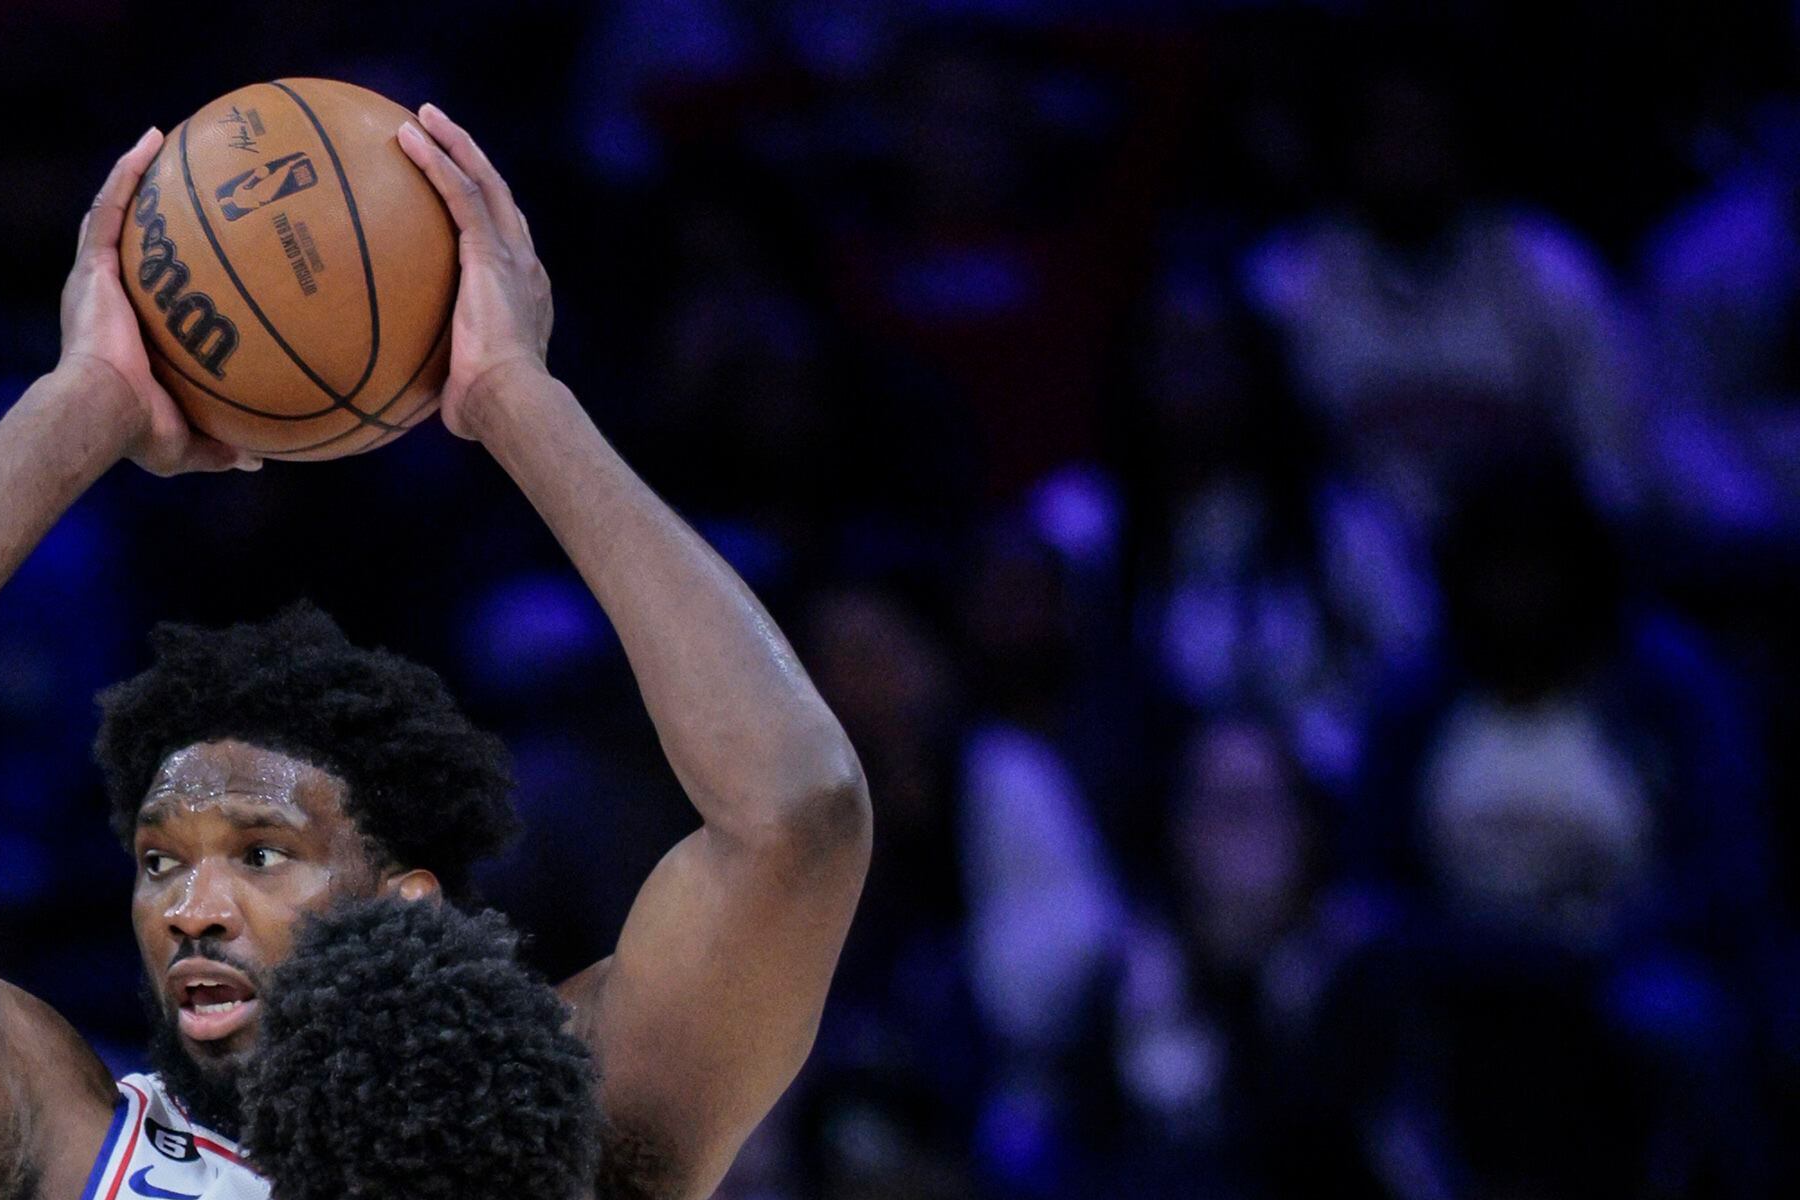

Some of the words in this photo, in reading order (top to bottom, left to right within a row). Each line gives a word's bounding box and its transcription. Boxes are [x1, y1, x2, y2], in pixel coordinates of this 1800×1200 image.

[271, 212, 292, 236] BALL
[280, 232, 302, 259] GAME
[135, 160, 239, 381] Wilso
[290, 256, 318, 297] OFFICIAL
[155, 1130, 187, 1159] 6
